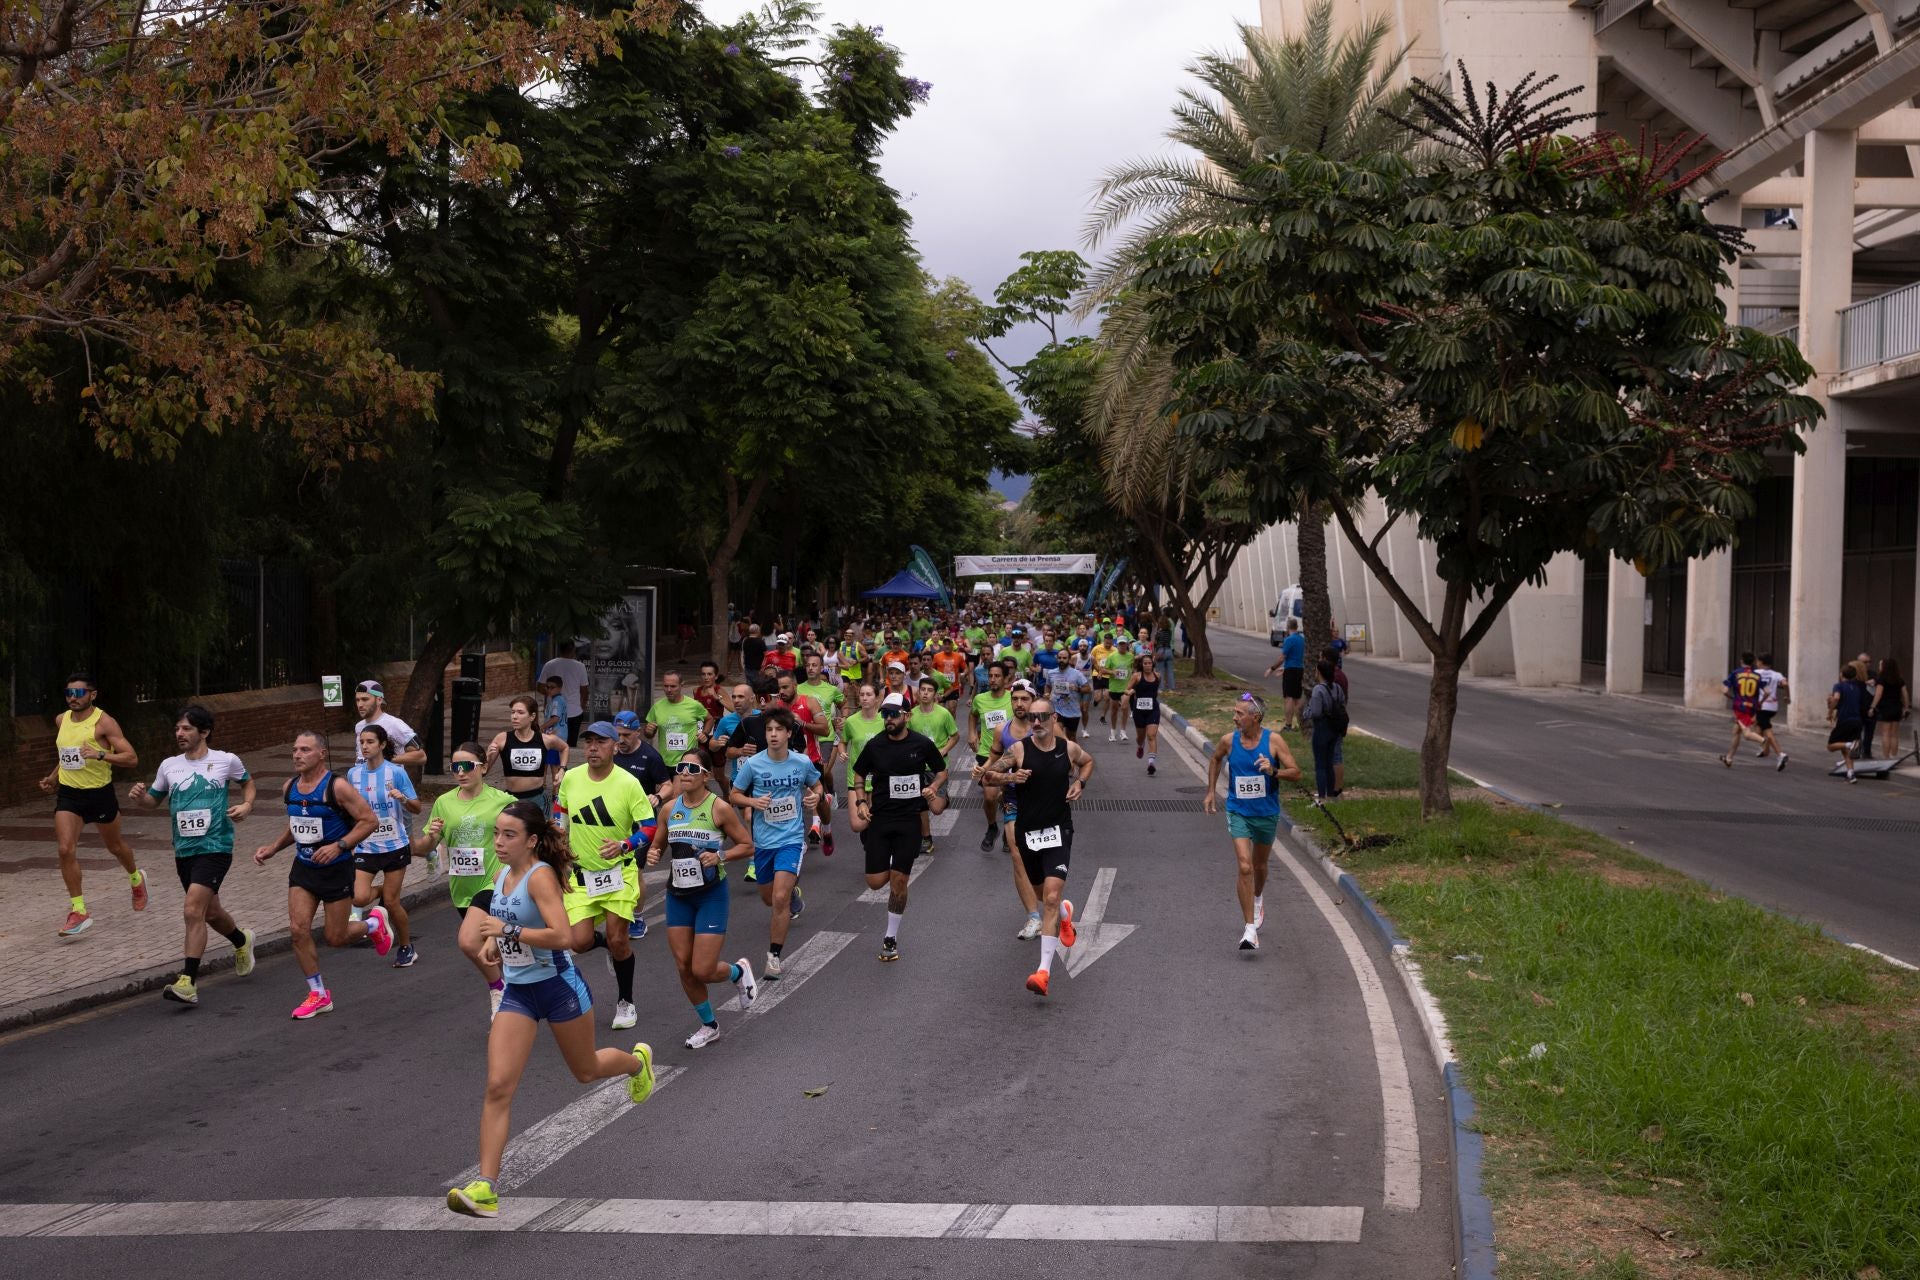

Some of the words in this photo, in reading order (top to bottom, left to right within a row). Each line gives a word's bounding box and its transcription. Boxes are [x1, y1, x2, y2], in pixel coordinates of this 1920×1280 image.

[607, 659, 635, 667] GLOSSY
[1738, 678, 1757, 697] 10
[514, 756, 537, 764] 302
[763, 775, 800, 788] nerja
[893, 782, 916, 792] 604
[1239, 783, 1261, 792] 583
[767, 803, 793, 814] 1030
[180, 818, 205, 830] 218
[292, 825, 318, 834] 1075
[1030, 834, 1057, 844] 1183
[452, 856, 479, 866] 1023
[594, 874, 612, 887] 54
[491, 907, 518, 921] nerja
